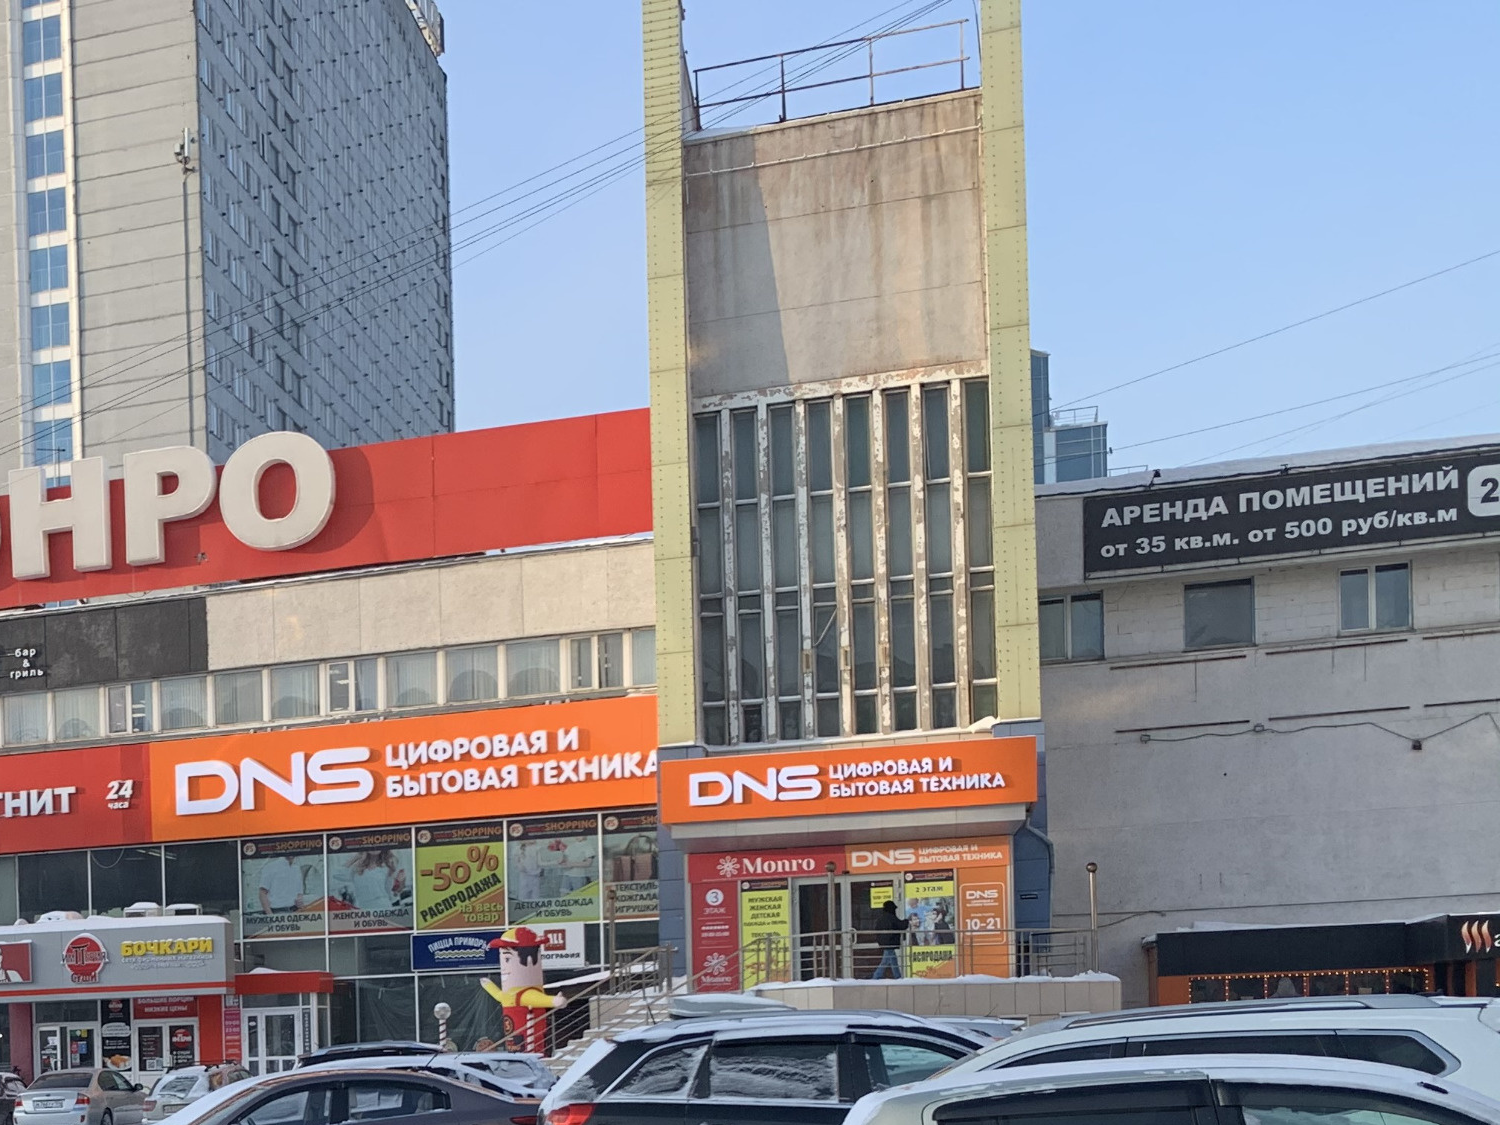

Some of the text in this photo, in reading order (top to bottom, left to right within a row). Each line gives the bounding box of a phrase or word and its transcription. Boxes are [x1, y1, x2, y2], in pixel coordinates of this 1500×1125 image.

[1101, 465, 1459, 528] АРЕНДА ПОМЕЩЕНИЙ
[1101, 507, 1458, 558] от 35 кв.м. от 500 руб/кв.м
[14, 648, 36, 657] бар
[22, 659, 30, 668] &
[10, 668, 43, 679] гриль
[385, 727, 579, 769] ЦИФРОВАЯ И
[829, 756, 953, 779] ЦИФРОВАЯ И
[385, 749, 657, 799] БЫТОВАЯ ТЕХНИКА
[175, 746, 375, 816] DNS
[689, 764, 822, 806] DNS
[829, 772, 1005, 798] БЫТОВАЯ ТЕХНИКА
[105, 779, 133, 800] 24
[544, 819, 596, 831] SHOPPING
[451, 827, 502, 838] SHOPPING
[275, 839, 322, 850] SHOPPING
[362, 833, 410, 845] SHOPPING
[919, 844, 978, 854] ЦИФРОВАЯ И
[851, 848, 916, 867] DNS
[919, 852, 1003, 863] БЫТОВАЯ ТЕХНИКА
[741, 855, 816, 875] Monro
[615, 882, 658, 891] ТЕКСТИЛЬ
[420, 873, 501, 923] РАСПРОДАЖА
[966, 889, 998, 899] DNS
[514, 897, 593, 910] ДЕТСКАЯ ОДЕЖДА
[615, 904, 658, 913] ИГРУШКИ
[333, 908, 409, 920] ЖЕНСКАЯ ОДЕЖДА
[464, 913, 498, 923] товар
[544, 907, 572, 917] ОБУВЬ
[246, 913, 322, 924] МУЖСКАЯ ОДЕЖДА
[354, 919, 388, 928] И ОБУВЬ
[965, 918, 1000, 930] 10-21
[275, 924, 300, 932] ОБУВЬ
[121, 937, 213, 957] БОЧКАРИ
[428, 937, 453, 953] ПИЦЦА
[540, 952, 580, 960] ПОГРАФИЯ
